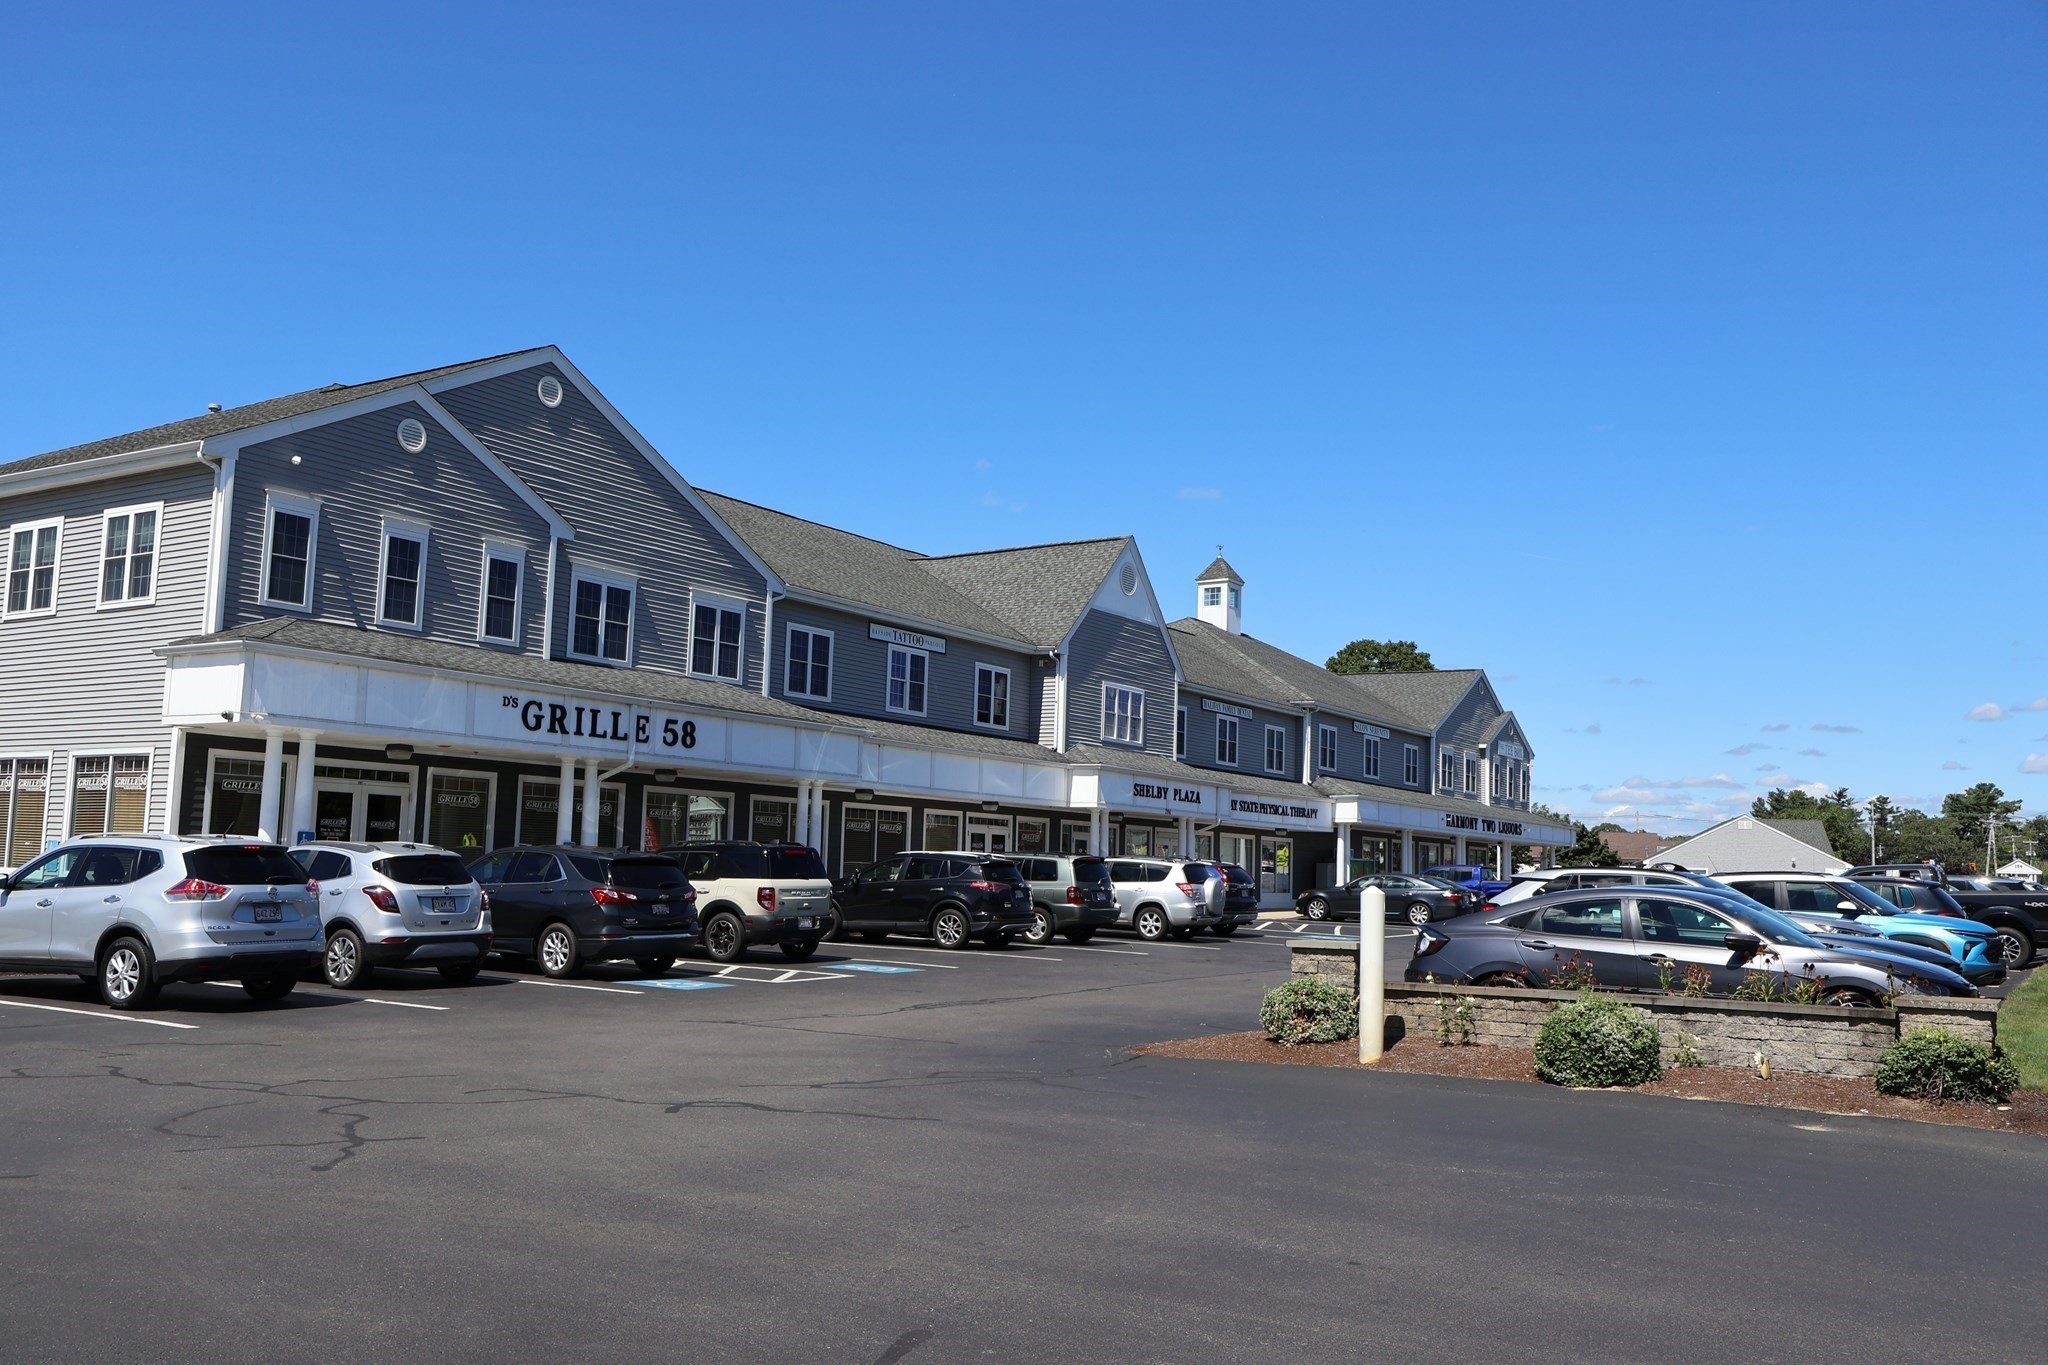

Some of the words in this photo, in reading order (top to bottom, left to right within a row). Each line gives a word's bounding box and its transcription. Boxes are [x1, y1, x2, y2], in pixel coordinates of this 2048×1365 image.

[892, 630, 925, 647] TATTOO
[502, 696, 519, 708] D'S
[521, 700, 650, 743] GRILLE
[662, 718, 697, 748] 58
[78, 778, 100, 786] GRILLE
[115, 777, 138, 785] GRILLE
[223, 780, 261, 790] GRILLE
[439, 795, 468, 803] GRILLE
[469, 796, 478, 804] 58
[1133, 783, 1169, 800] SHELBY
[1173, 788, 1201, 804] PLAZA
[1239, 801, 1259, 813] STATE
[1259, 803, 1290, 816] PHYSICAL
[1290, 806, 1318, 819] THERAPY
[1446, 813, 1478, 830] HARMONY
[1482, 819, 1496, 832] TWO
[1498, 821, 1523, 835] LIQUORS
